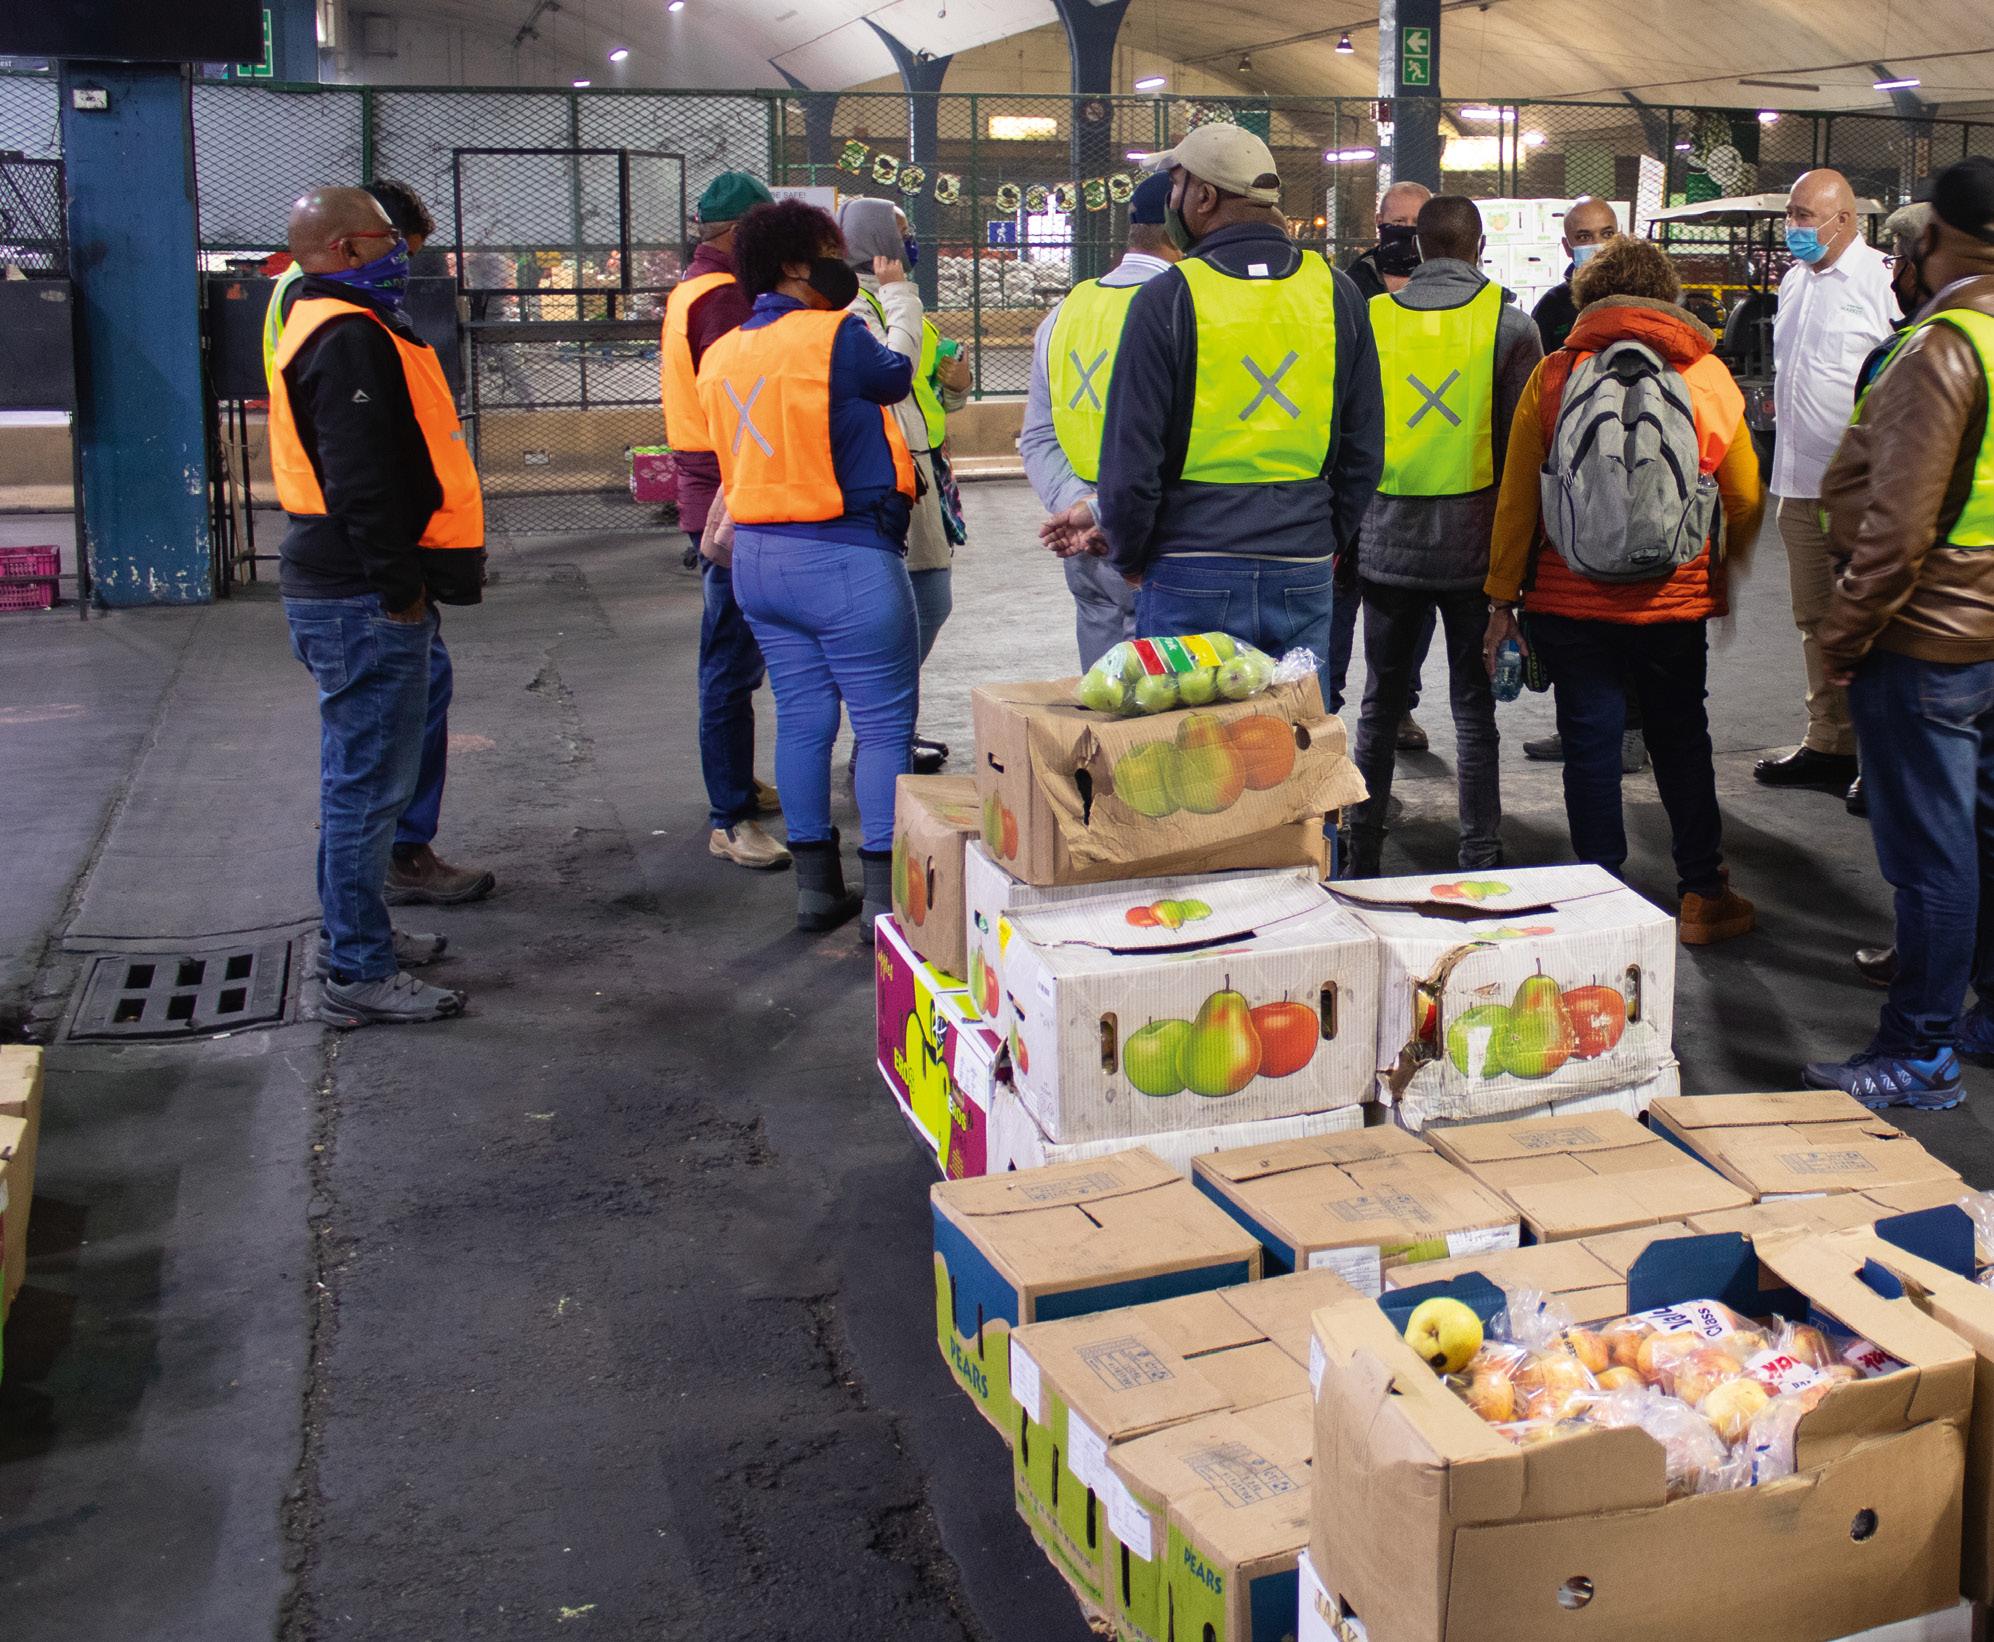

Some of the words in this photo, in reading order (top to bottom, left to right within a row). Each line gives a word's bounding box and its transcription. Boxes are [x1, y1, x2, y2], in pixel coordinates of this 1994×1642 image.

[1697, 1307, 1723, 1337] Class
[949, 1335, 989, 1399] PEARS
[1183, 1545, 1223, 1595] PEARS
